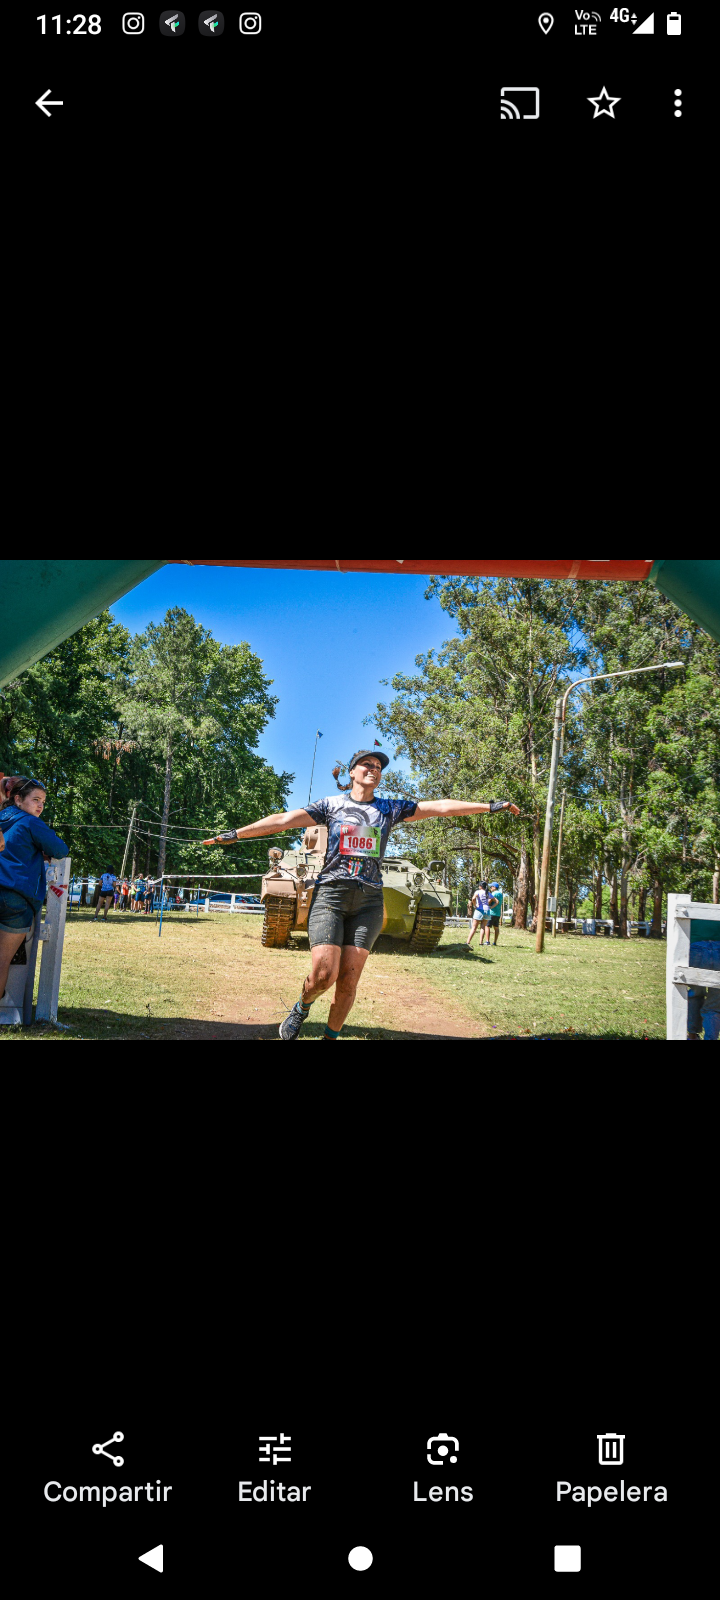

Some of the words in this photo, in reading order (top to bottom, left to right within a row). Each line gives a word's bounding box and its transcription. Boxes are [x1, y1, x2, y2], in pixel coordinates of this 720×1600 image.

[36, 14, 102, 36] 11:28
[574, 9, 591, 21] Vo
[609, 7, 630, 23] 4G
[574, 24, 597, 36] LTE
[347, 836, 373, 850] 1086
[43, 1479, 173, 1508] Compartir
[238, 1479, 312, 1503] Editar
[413, 1480, 474, 1503] Lens
[556, 1479, 668, 1508] Papelera
